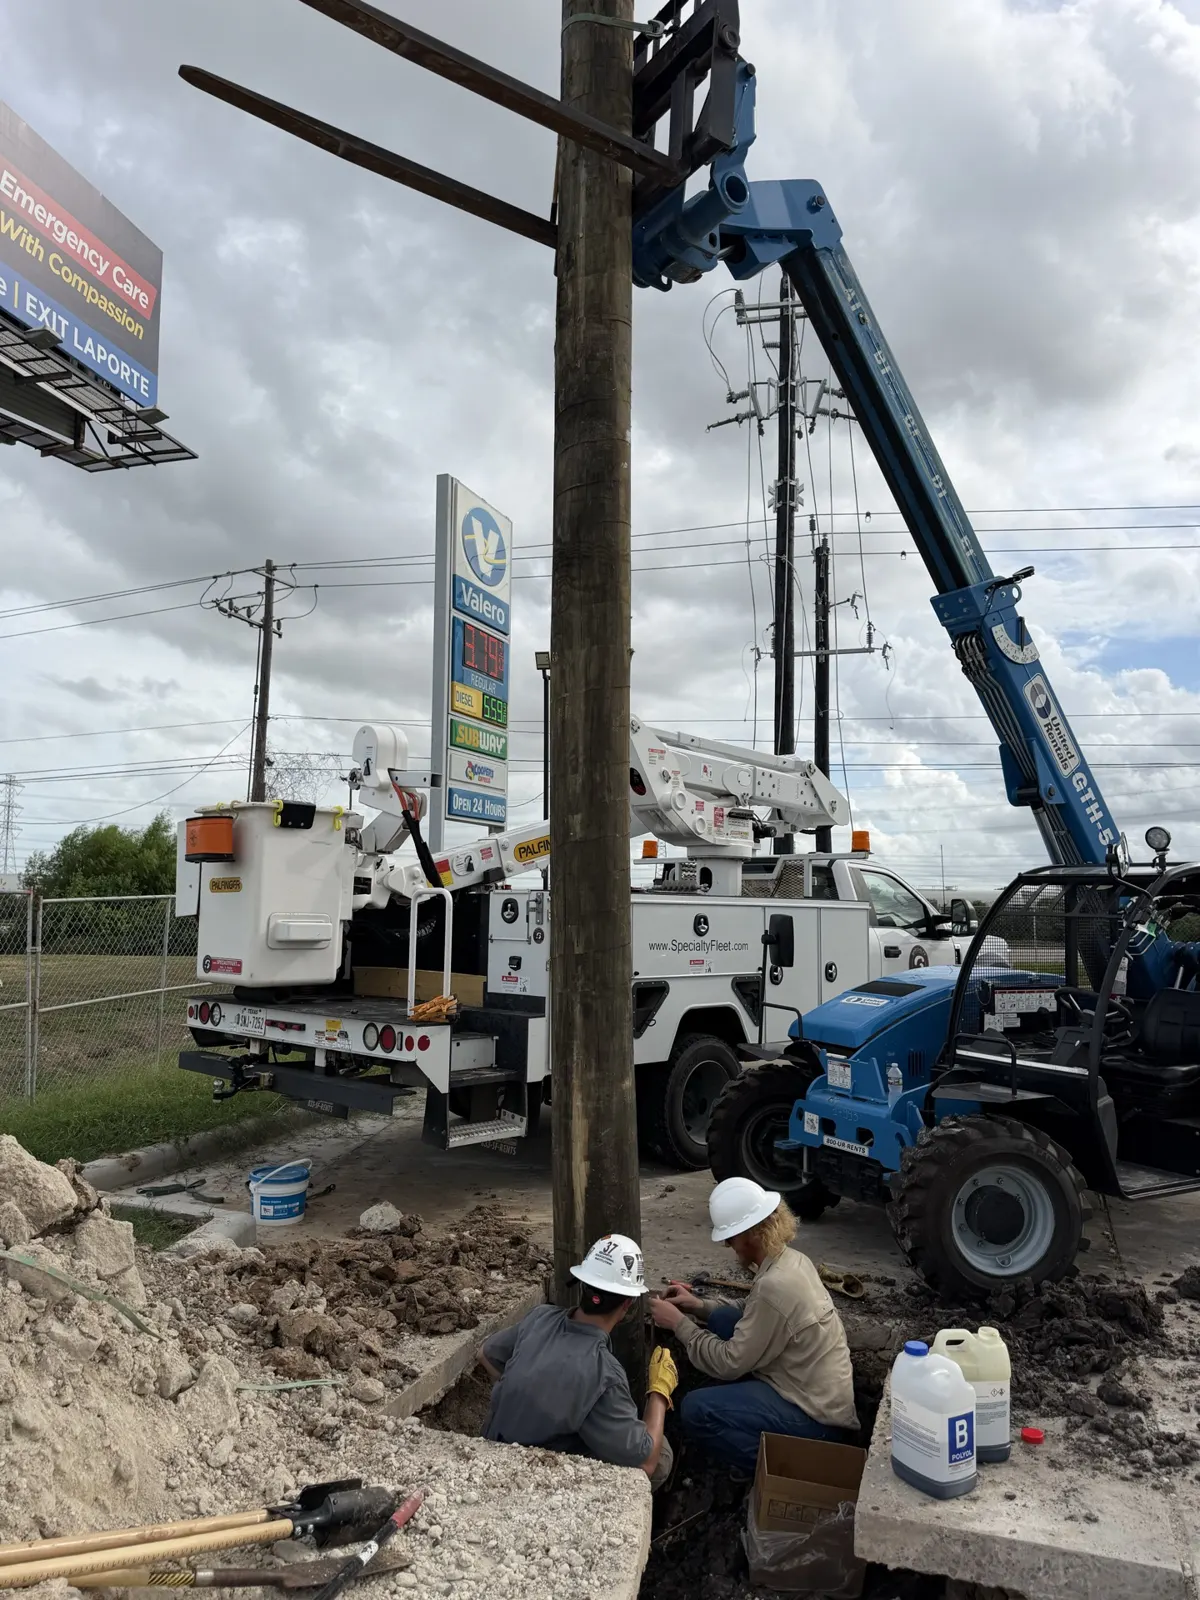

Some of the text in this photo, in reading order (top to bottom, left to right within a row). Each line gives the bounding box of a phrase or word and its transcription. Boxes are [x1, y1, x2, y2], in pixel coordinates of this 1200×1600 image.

[0, 170, 149, 309] Emergency Care
[1, 211, 144, 340] With Compassion
[26, 292, 149, 398] EXIT LAPORTE
[461, 582, 505, 625] Valero
[471, 673, 496, 694] REGULAR
[456, 691, 474, 708] DIESEL
[456, 724, 505, 754] SUBWAY
[1043, 722, 1069, 770] Rentals
[1051, 716, 1075, 759] United
[473, 798, 483, 813] 24
[648, 939, 749, 954] www.SpecialtyFleet.com
[603, 1241, 619, 1254] 37
[955, 1418, 968, 1449] B
[951, 1450, 972, 1461] POLYOL
